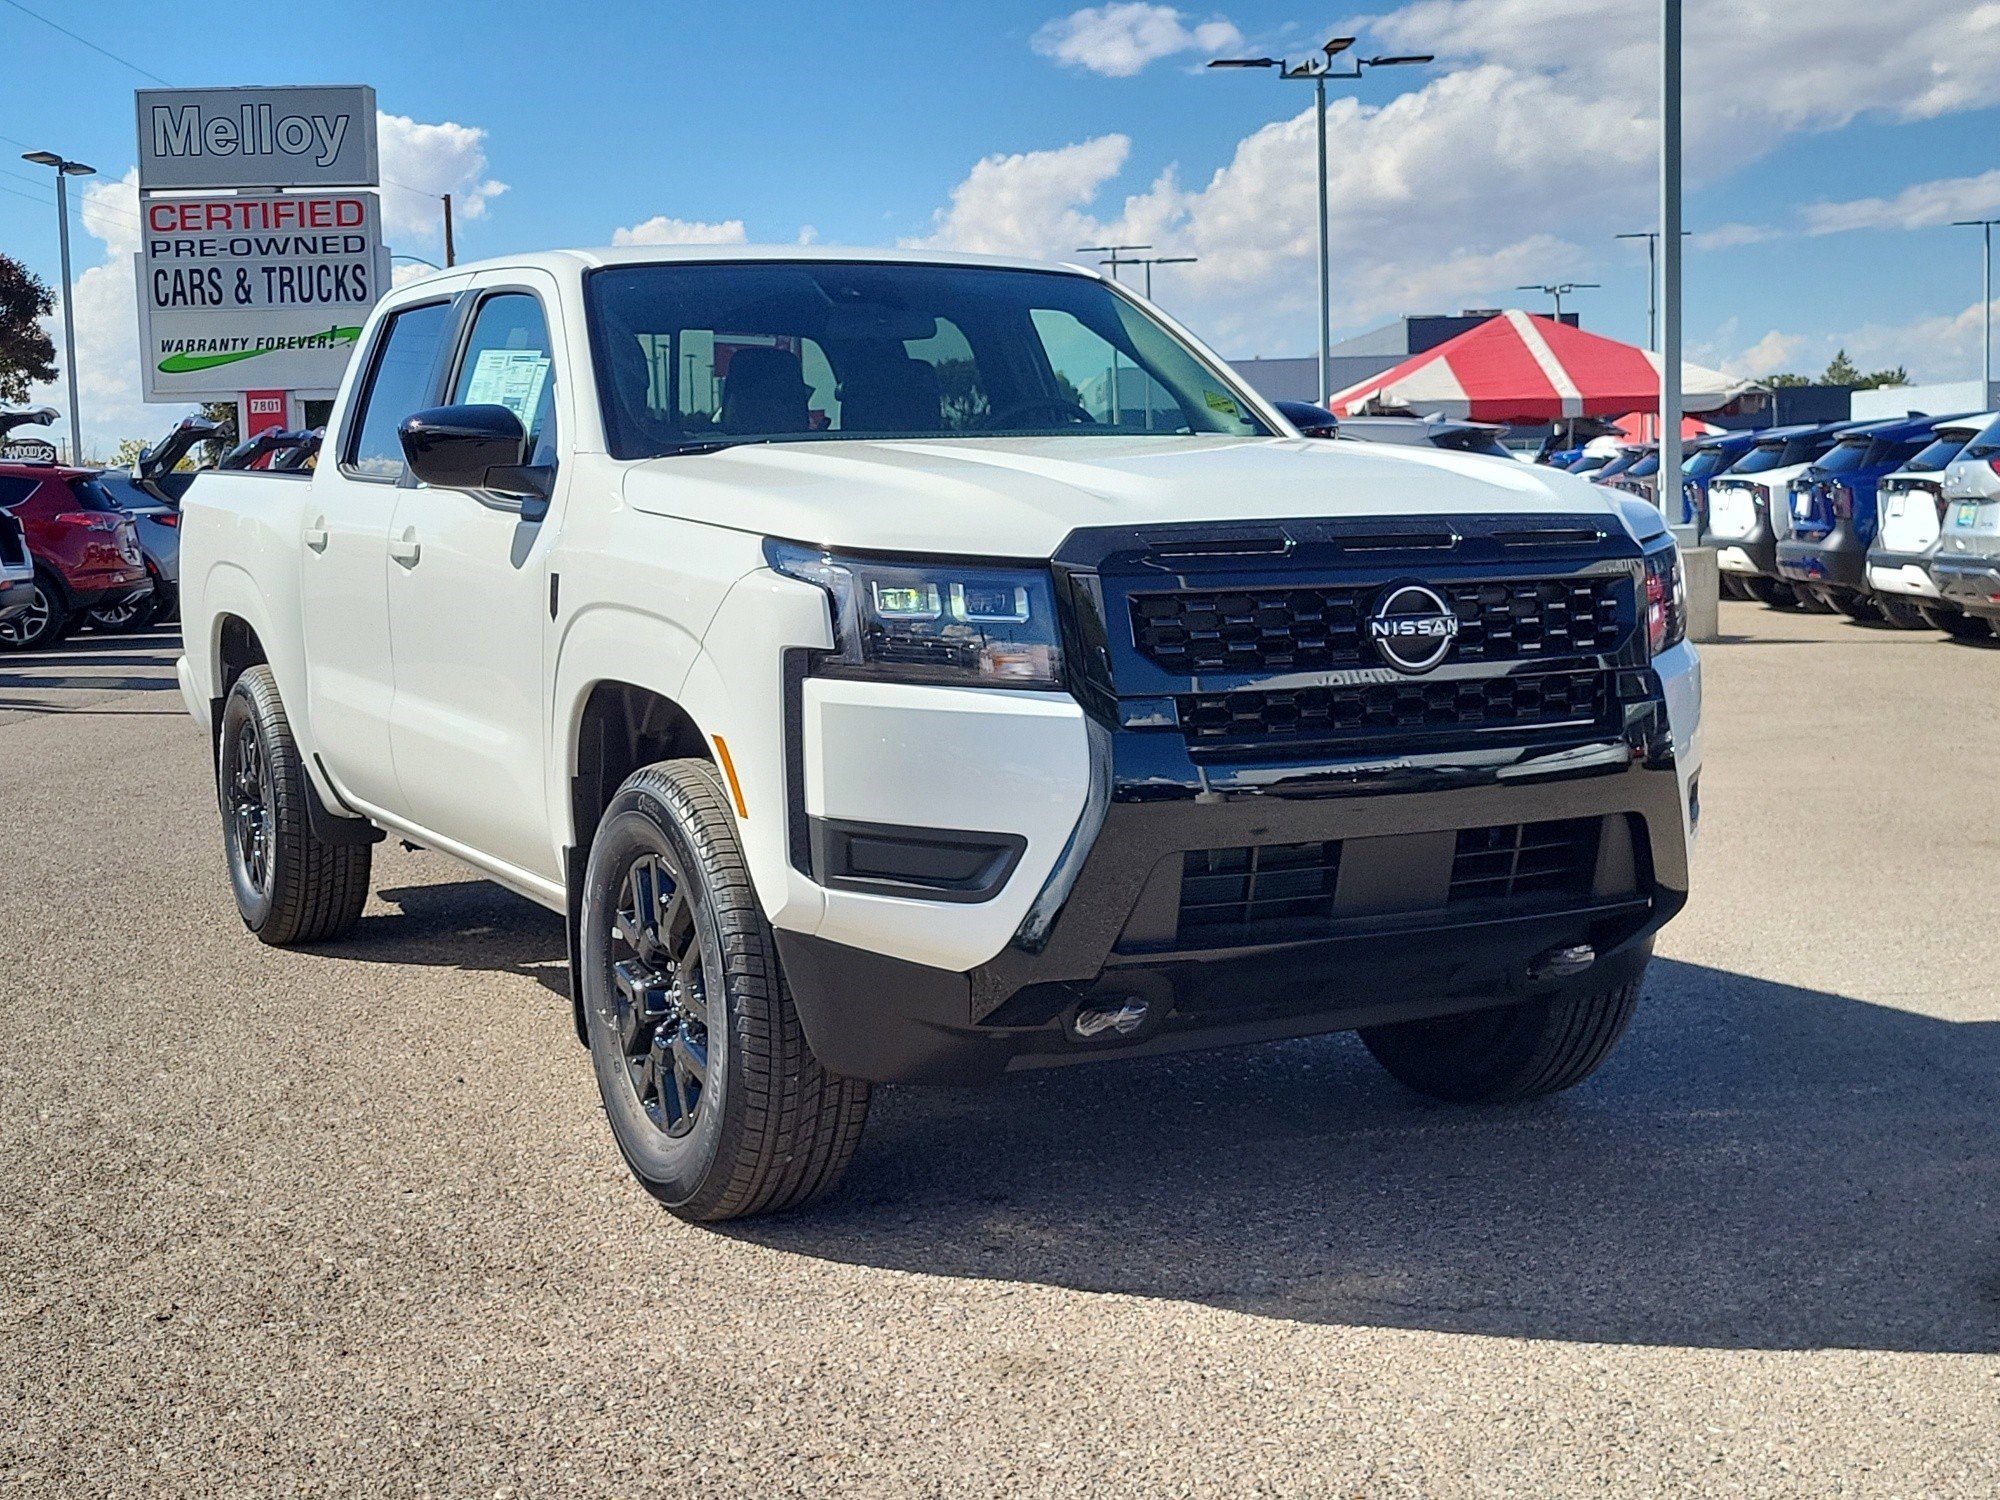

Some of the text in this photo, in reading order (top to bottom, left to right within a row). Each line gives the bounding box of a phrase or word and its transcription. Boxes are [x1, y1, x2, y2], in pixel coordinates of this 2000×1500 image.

[152, 103, 349, 168] Melloy
[149, 200, 364, 232] CERTIFIED
[151, 235, 366, 258] PRE-OWNED
[154, 264, 367, 307] CARS & TRUCKS
[161, 325, 338, 353] WARRANTY FOREVER!
[253, 401, 279, 412] 7801
[1371, 619, 1458, 637] NISSAN
